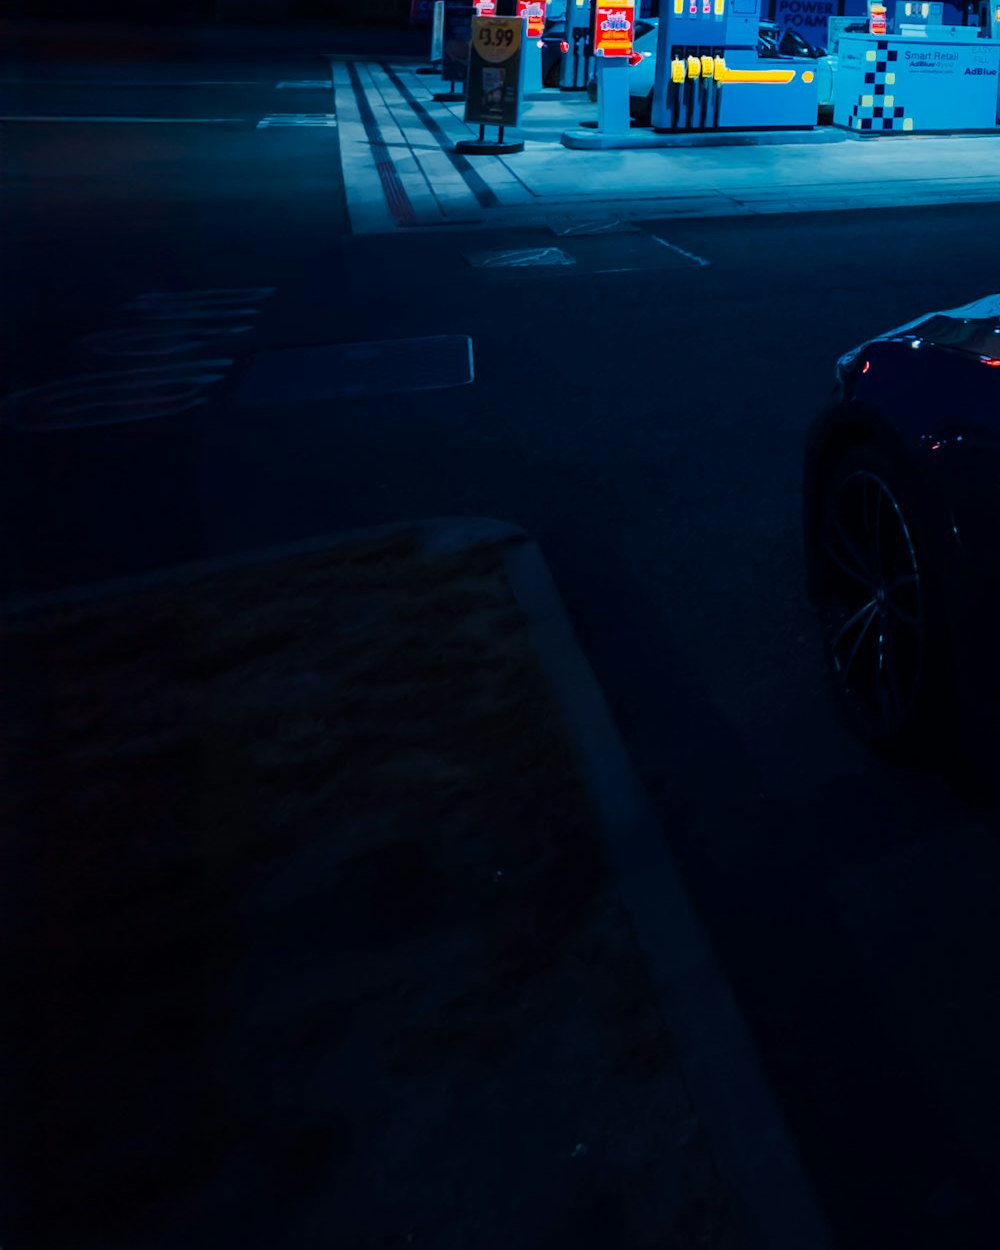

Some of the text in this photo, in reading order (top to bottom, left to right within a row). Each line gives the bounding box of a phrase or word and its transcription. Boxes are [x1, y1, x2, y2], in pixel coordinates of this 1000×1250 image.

[779, 0, 834, 14] POWER
[479, 27, 514, 47] £3.99
[904, 51, 959, 61] Smart Retail
[965, 67, 997, 76] AdBlue
